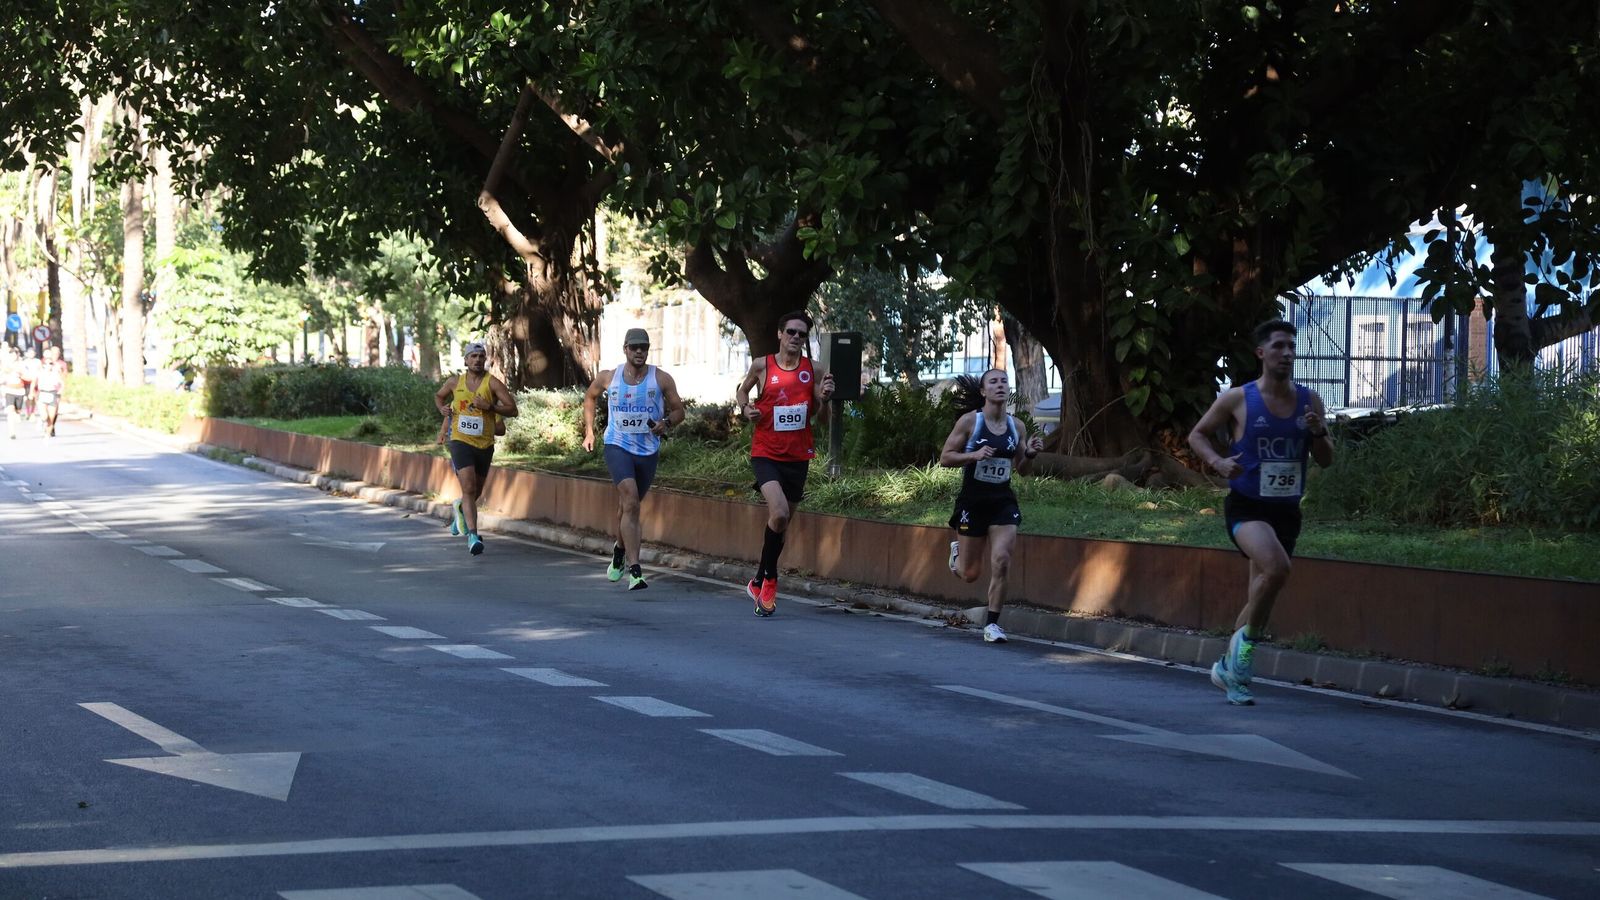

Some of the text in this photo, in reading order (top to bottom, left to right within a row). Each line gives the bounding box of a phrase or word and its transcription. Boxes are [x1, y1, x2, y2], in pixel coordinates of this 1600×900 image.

[622, 419, 642, 427] 947
[779, 414, 802, 424] 690
[461, 421, 479, 430] 950
[1257, 436, 1305, 459] RCM
[982, 465, 1005, 477] 110
[1267, 475, 1296, 486] 736
